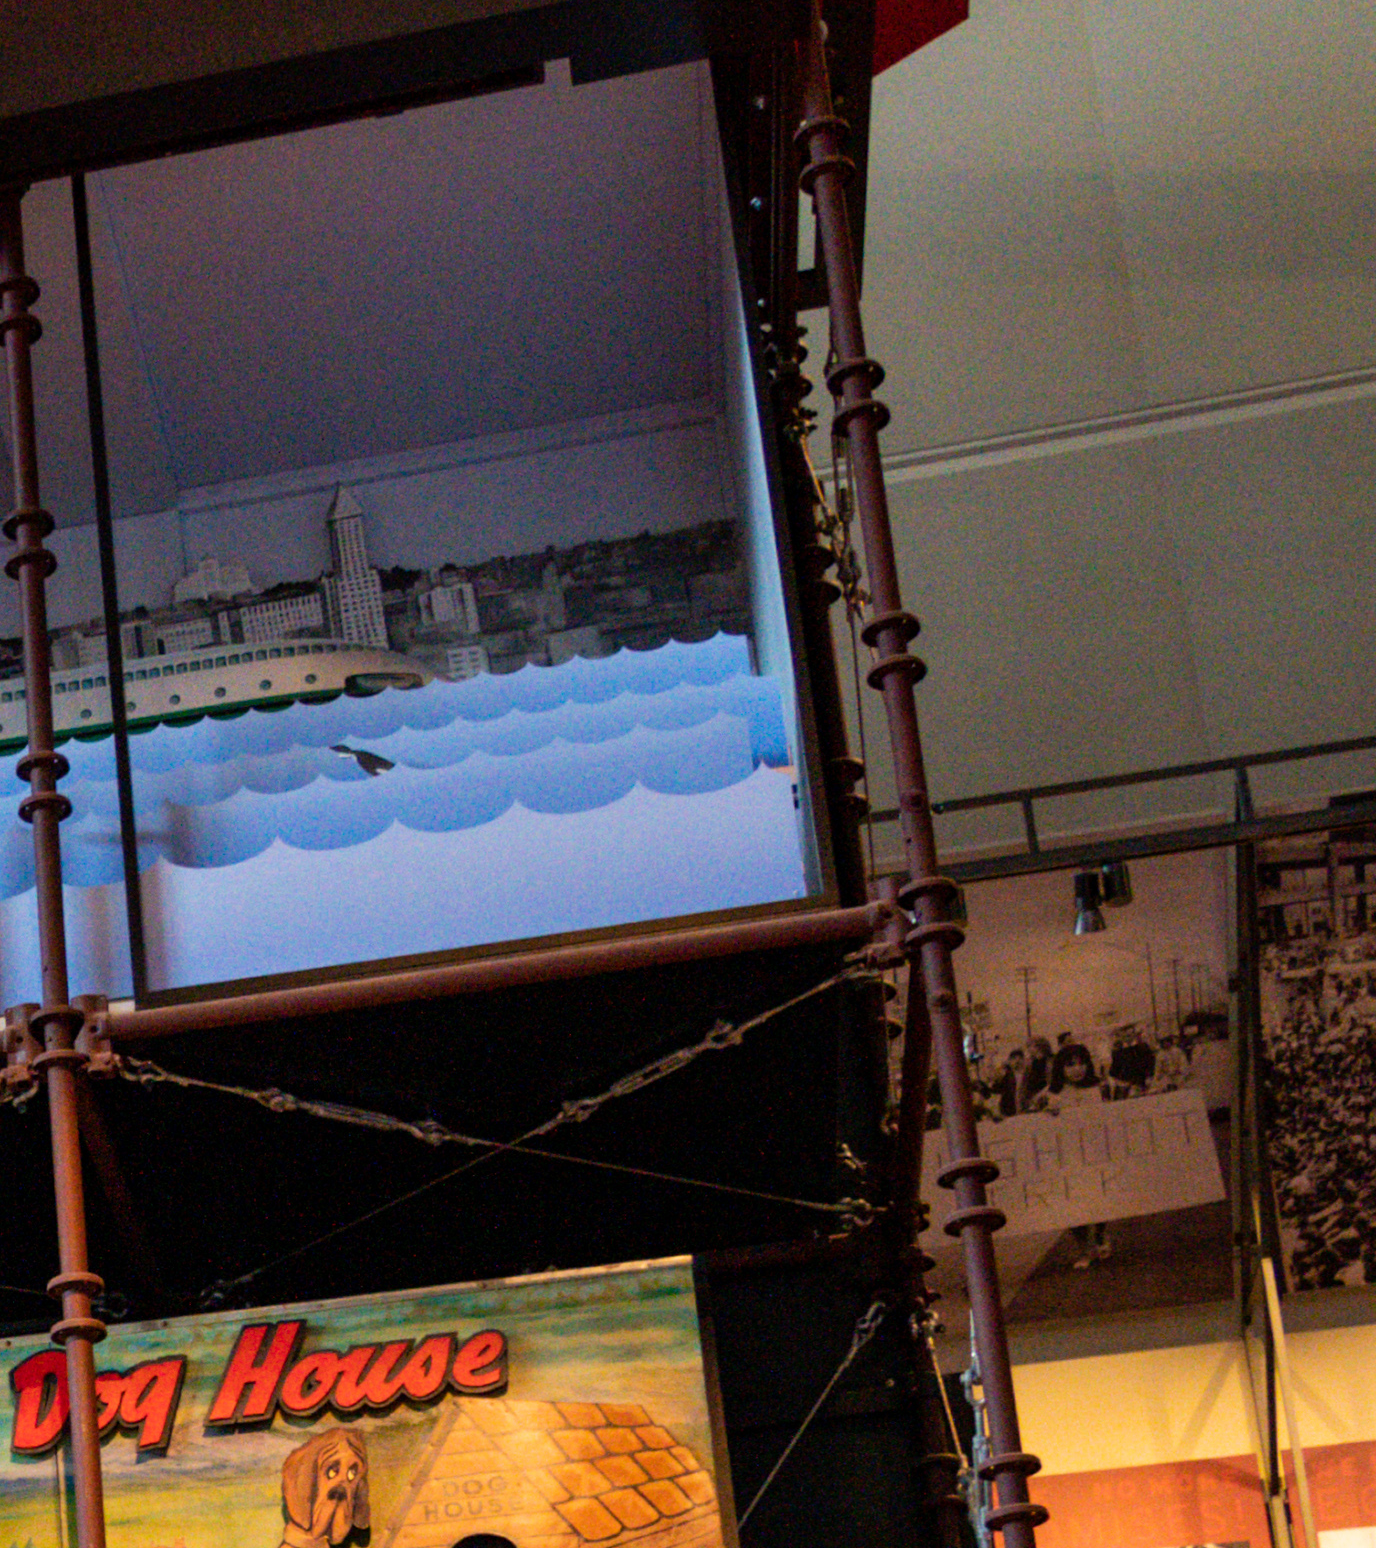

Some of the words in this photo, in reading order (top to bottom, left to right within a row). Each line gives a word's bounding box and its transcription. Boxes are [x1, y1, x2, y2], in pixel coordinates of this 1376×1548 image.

[9, 1348, 187, 1456] Dog
[205, 1319, 509, 1428] House
[443, 1475, 507, 1497] DOG
[424, 1498, 525, 1521] HOUSE
